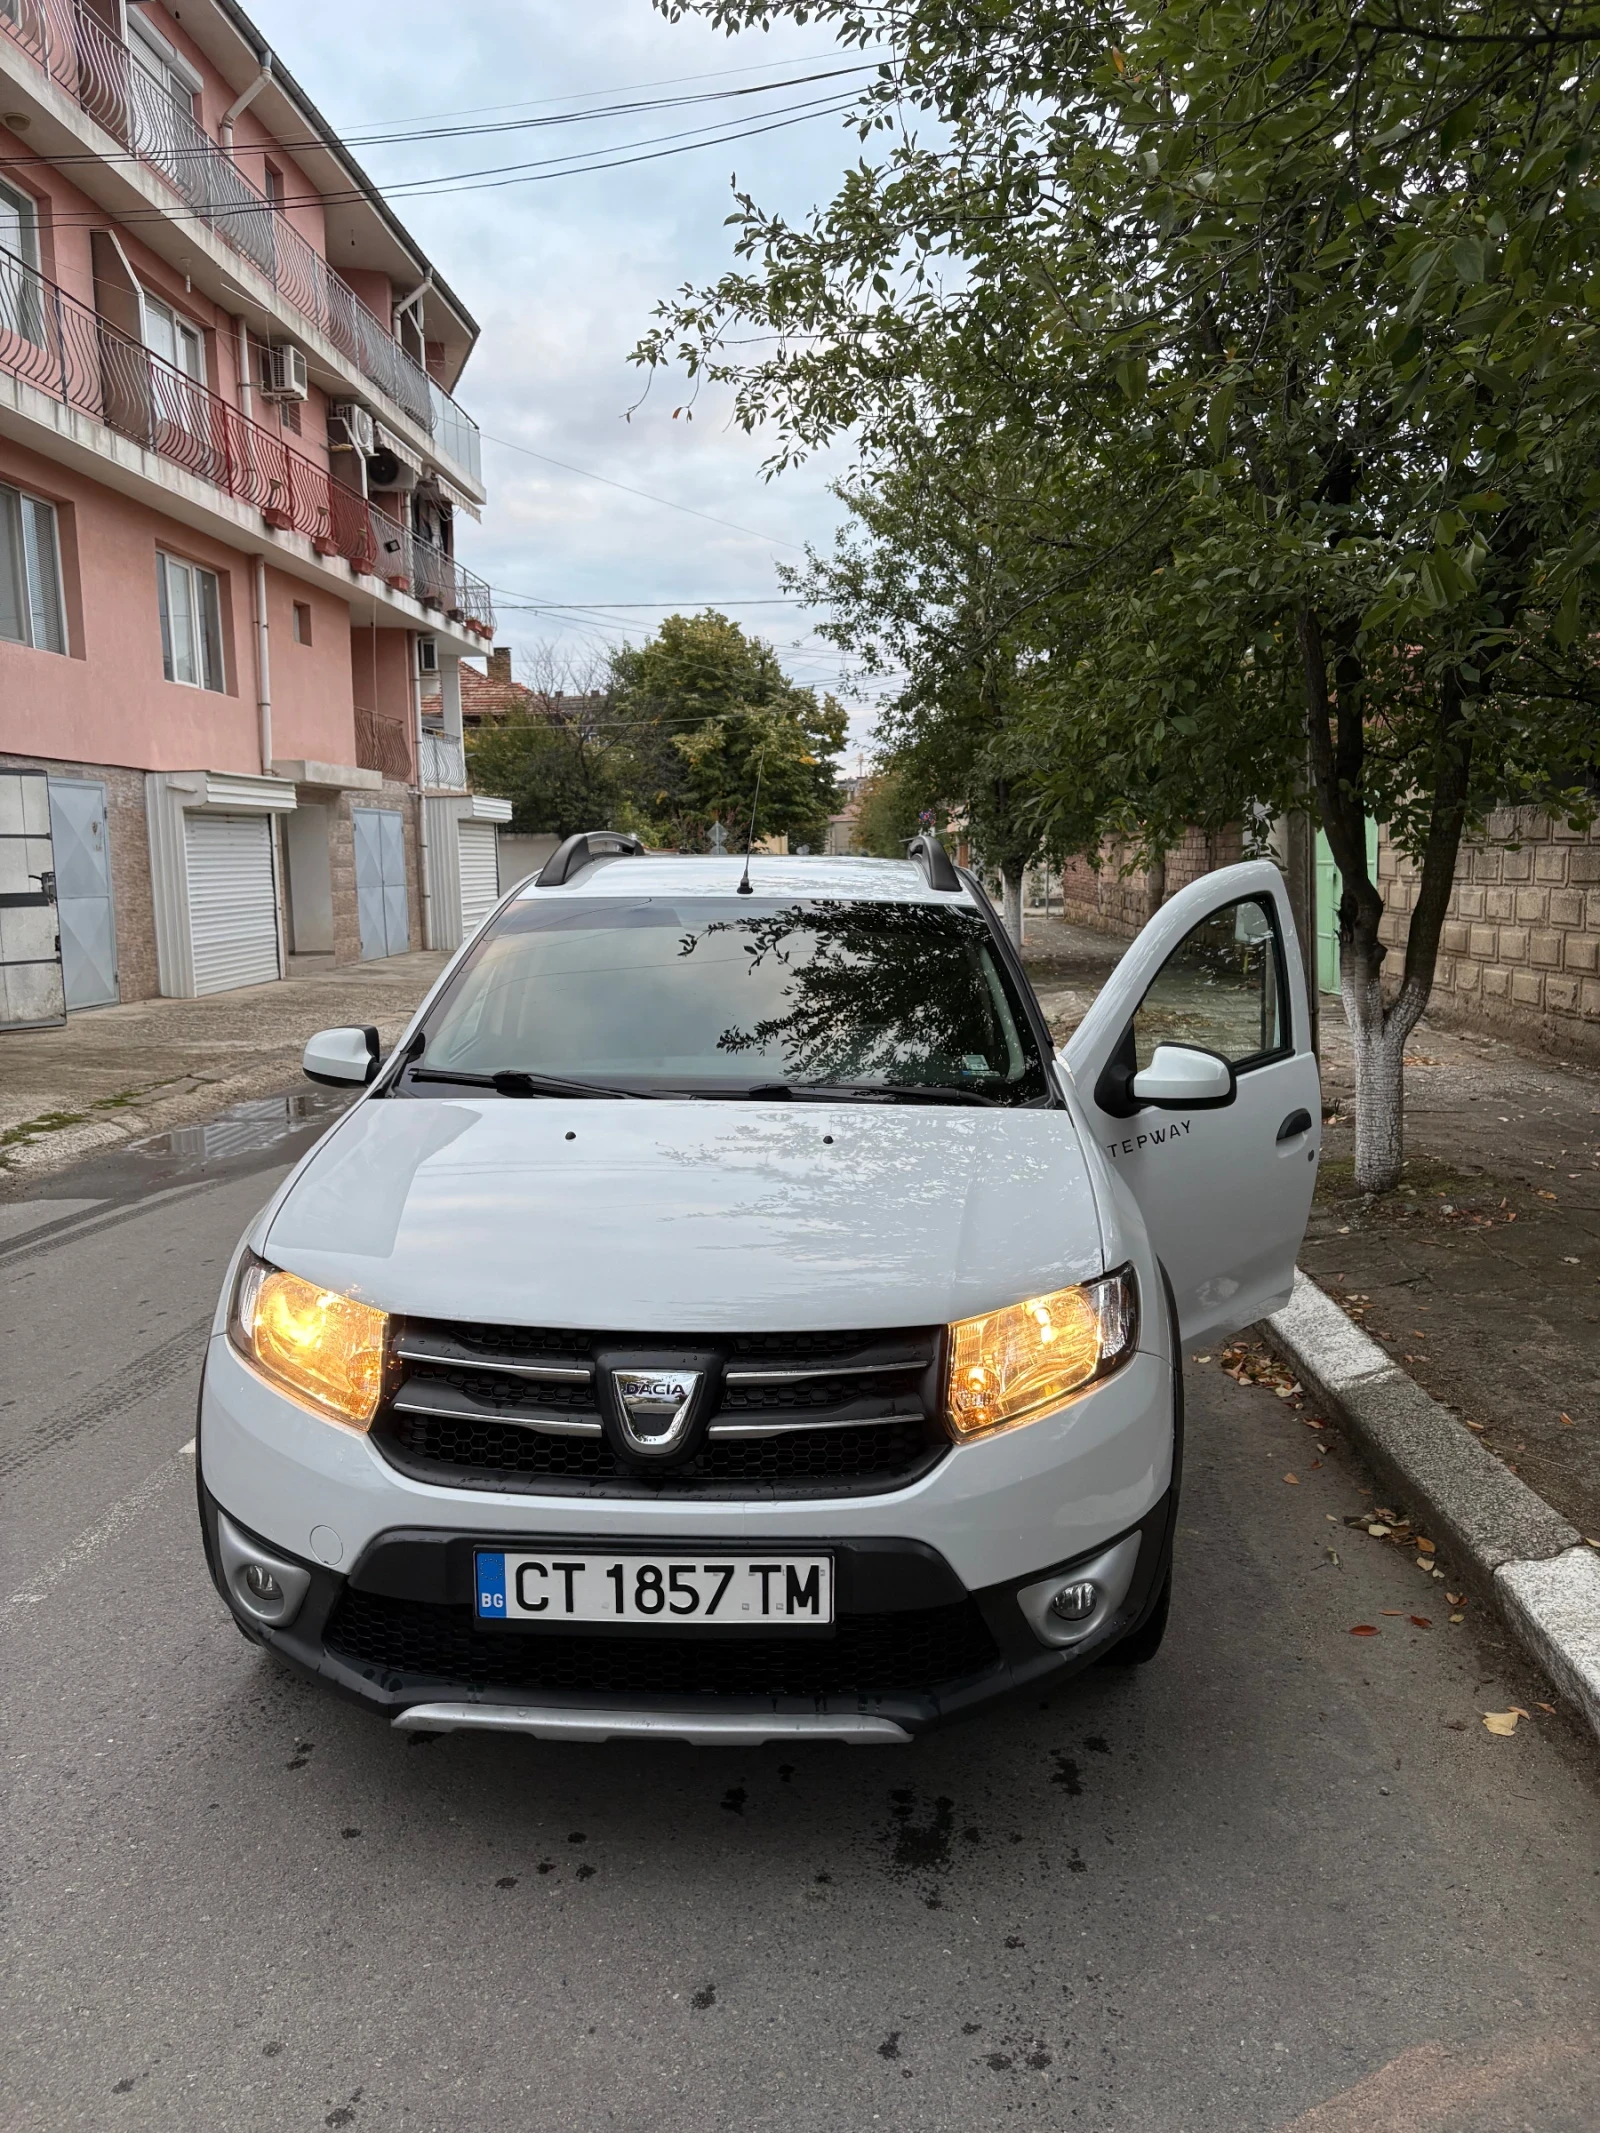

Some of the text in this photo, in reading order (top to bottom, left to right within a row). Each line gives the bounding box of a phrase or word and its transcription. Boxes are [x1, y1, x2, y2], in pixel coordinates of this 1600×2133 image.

[1106, 1120, 1191, 1158] TEPWAY
[626, 1383, 685, 1395] DACIA
[481, 1592, 504, 1608] BG
[515, 1561, 820, 1615] CT 1857 TM
